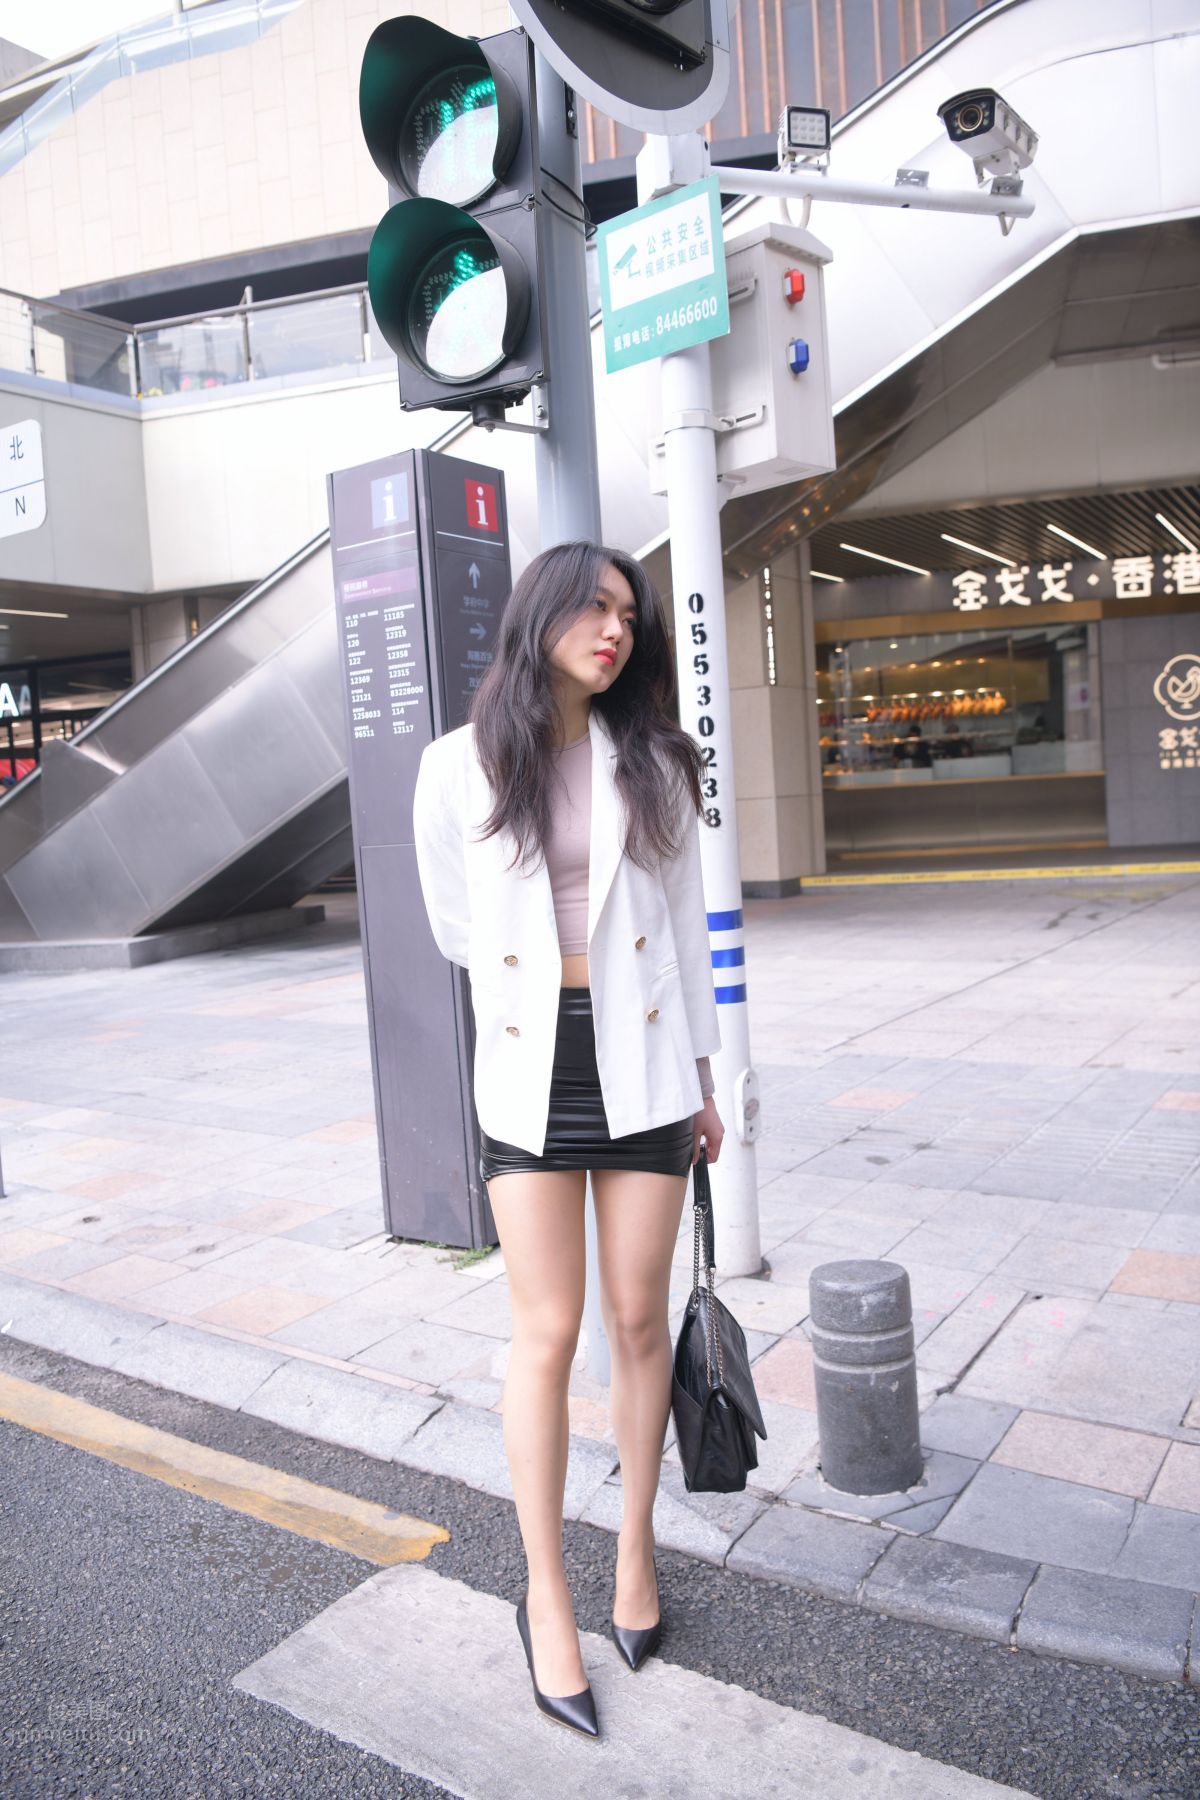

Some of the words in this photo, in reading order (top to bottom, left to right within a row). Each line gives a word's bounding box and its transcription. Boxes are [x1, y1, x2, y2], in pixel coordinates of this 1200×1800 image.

[646, 217, 705, 254] 公共安全
[644, 240, 710, 279] 视频采集区域
[9, 435, 24, 461] 北
[15, 495, 27, 516] N
[384, 611, 405, 621] 11185
[345, 620, 358, 628] 110
[386, 630, 407, 640] 12319
[347, 639, 360, 648] 120
[349, 657, 361, 666] 122
[389, 669, 410, 678] 12315
[352, 693, 372, 703] 12121
[391, 708, 405, 716] 114
